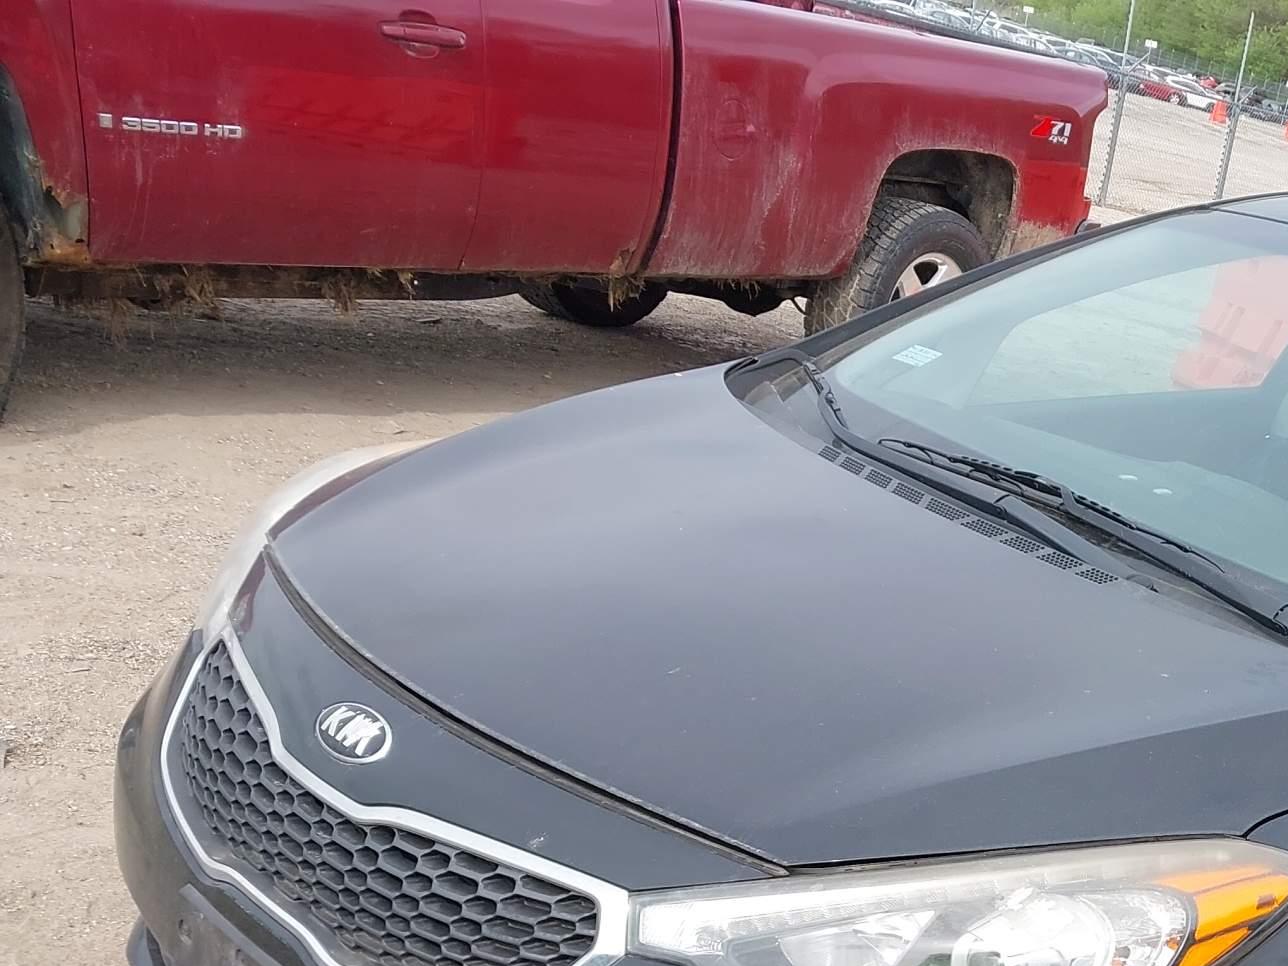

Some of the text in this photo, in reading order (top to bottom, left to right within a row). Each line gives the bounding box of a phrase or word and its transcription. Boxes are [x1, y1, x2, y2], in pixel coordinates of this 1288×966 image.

[121, 116, 243, 139] 3500 HD
[1030, 116, 1072, 137] Z71
